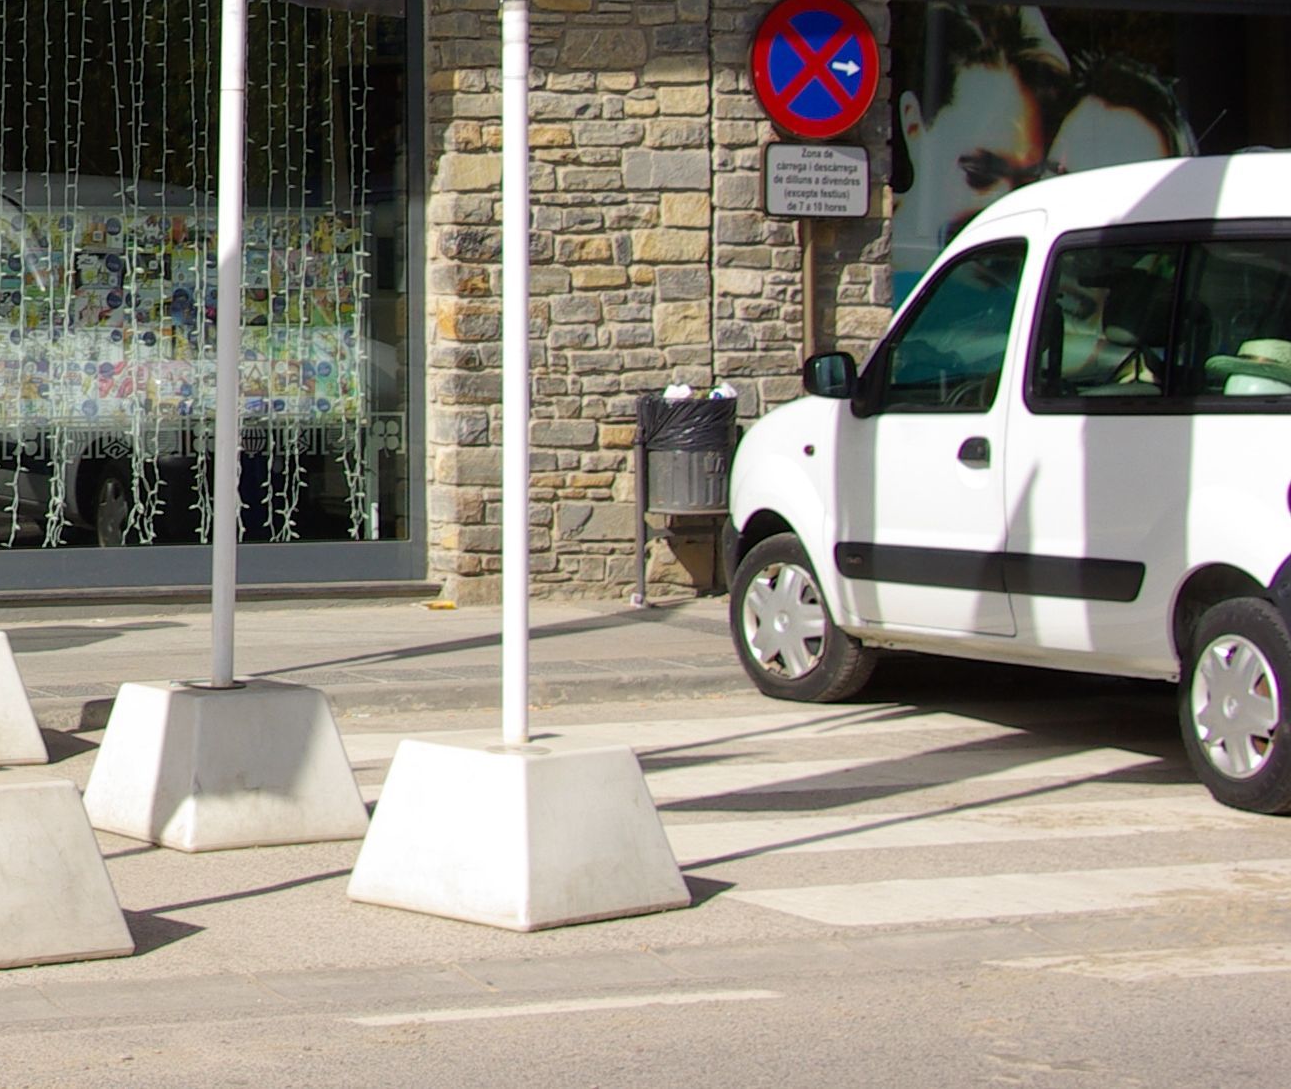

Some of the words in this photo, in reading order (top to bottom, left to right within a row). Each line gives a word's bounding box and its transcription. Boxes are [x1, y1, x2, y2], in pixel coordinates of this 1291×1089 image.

[802, 148, 821, 158] Zona
[824, 148, 833, 159] de
[774, 175, 783, 184] de
[786, 175, 812, 184] dilluns
[822, 177, 861, 186] divendres
[787, 202, 796, 211] de
[824, 203, 847, 212] hores
